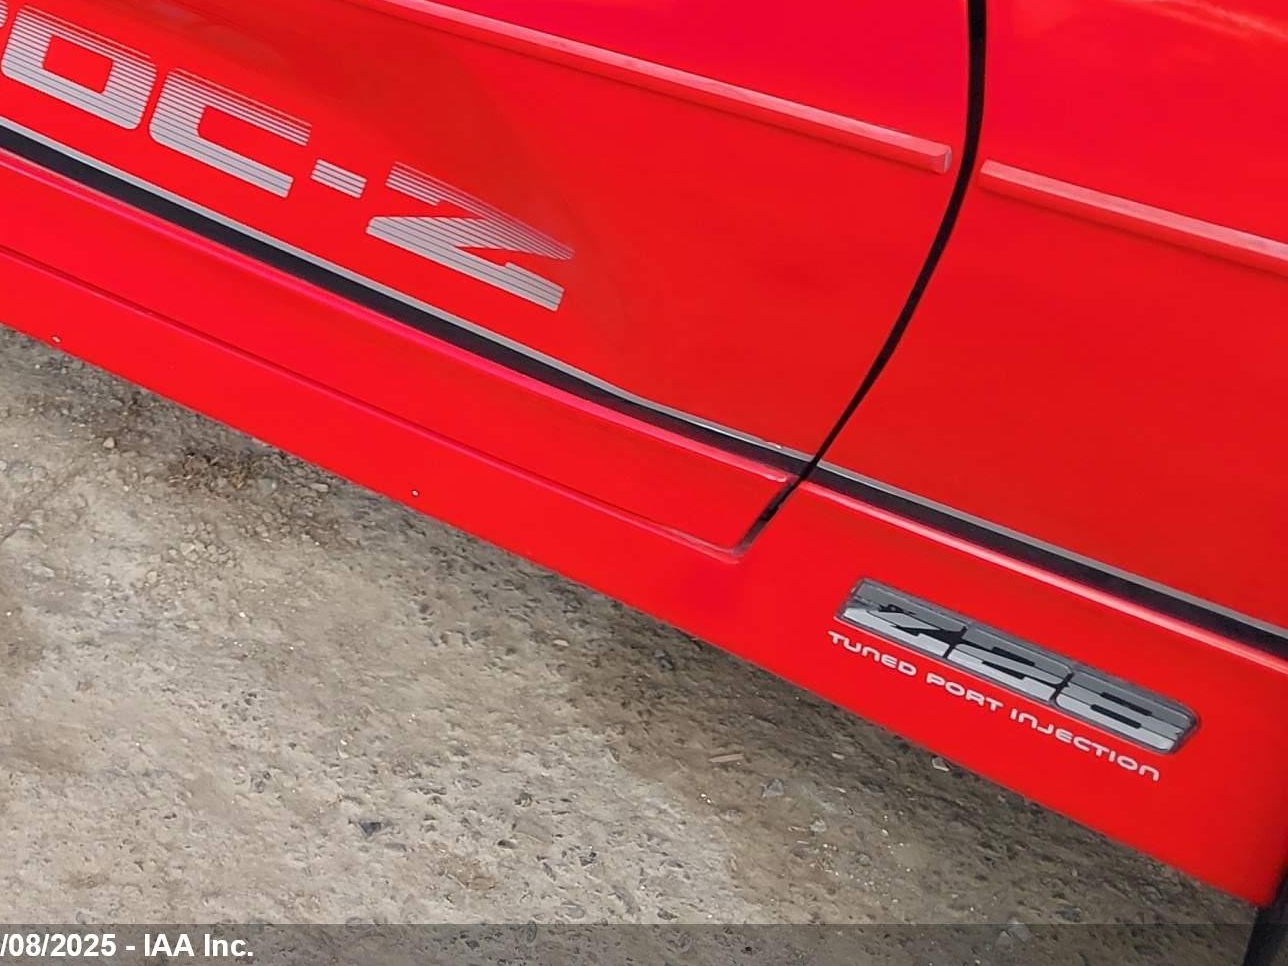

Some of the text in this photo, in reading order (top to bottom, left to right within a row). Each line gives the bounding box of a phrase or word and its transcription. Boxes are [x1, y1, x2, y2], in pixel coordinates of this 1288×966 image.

[827, 630, 1161, 783] TUNED PORT INJECTION
[838, 579, 1197, 752] Z28
